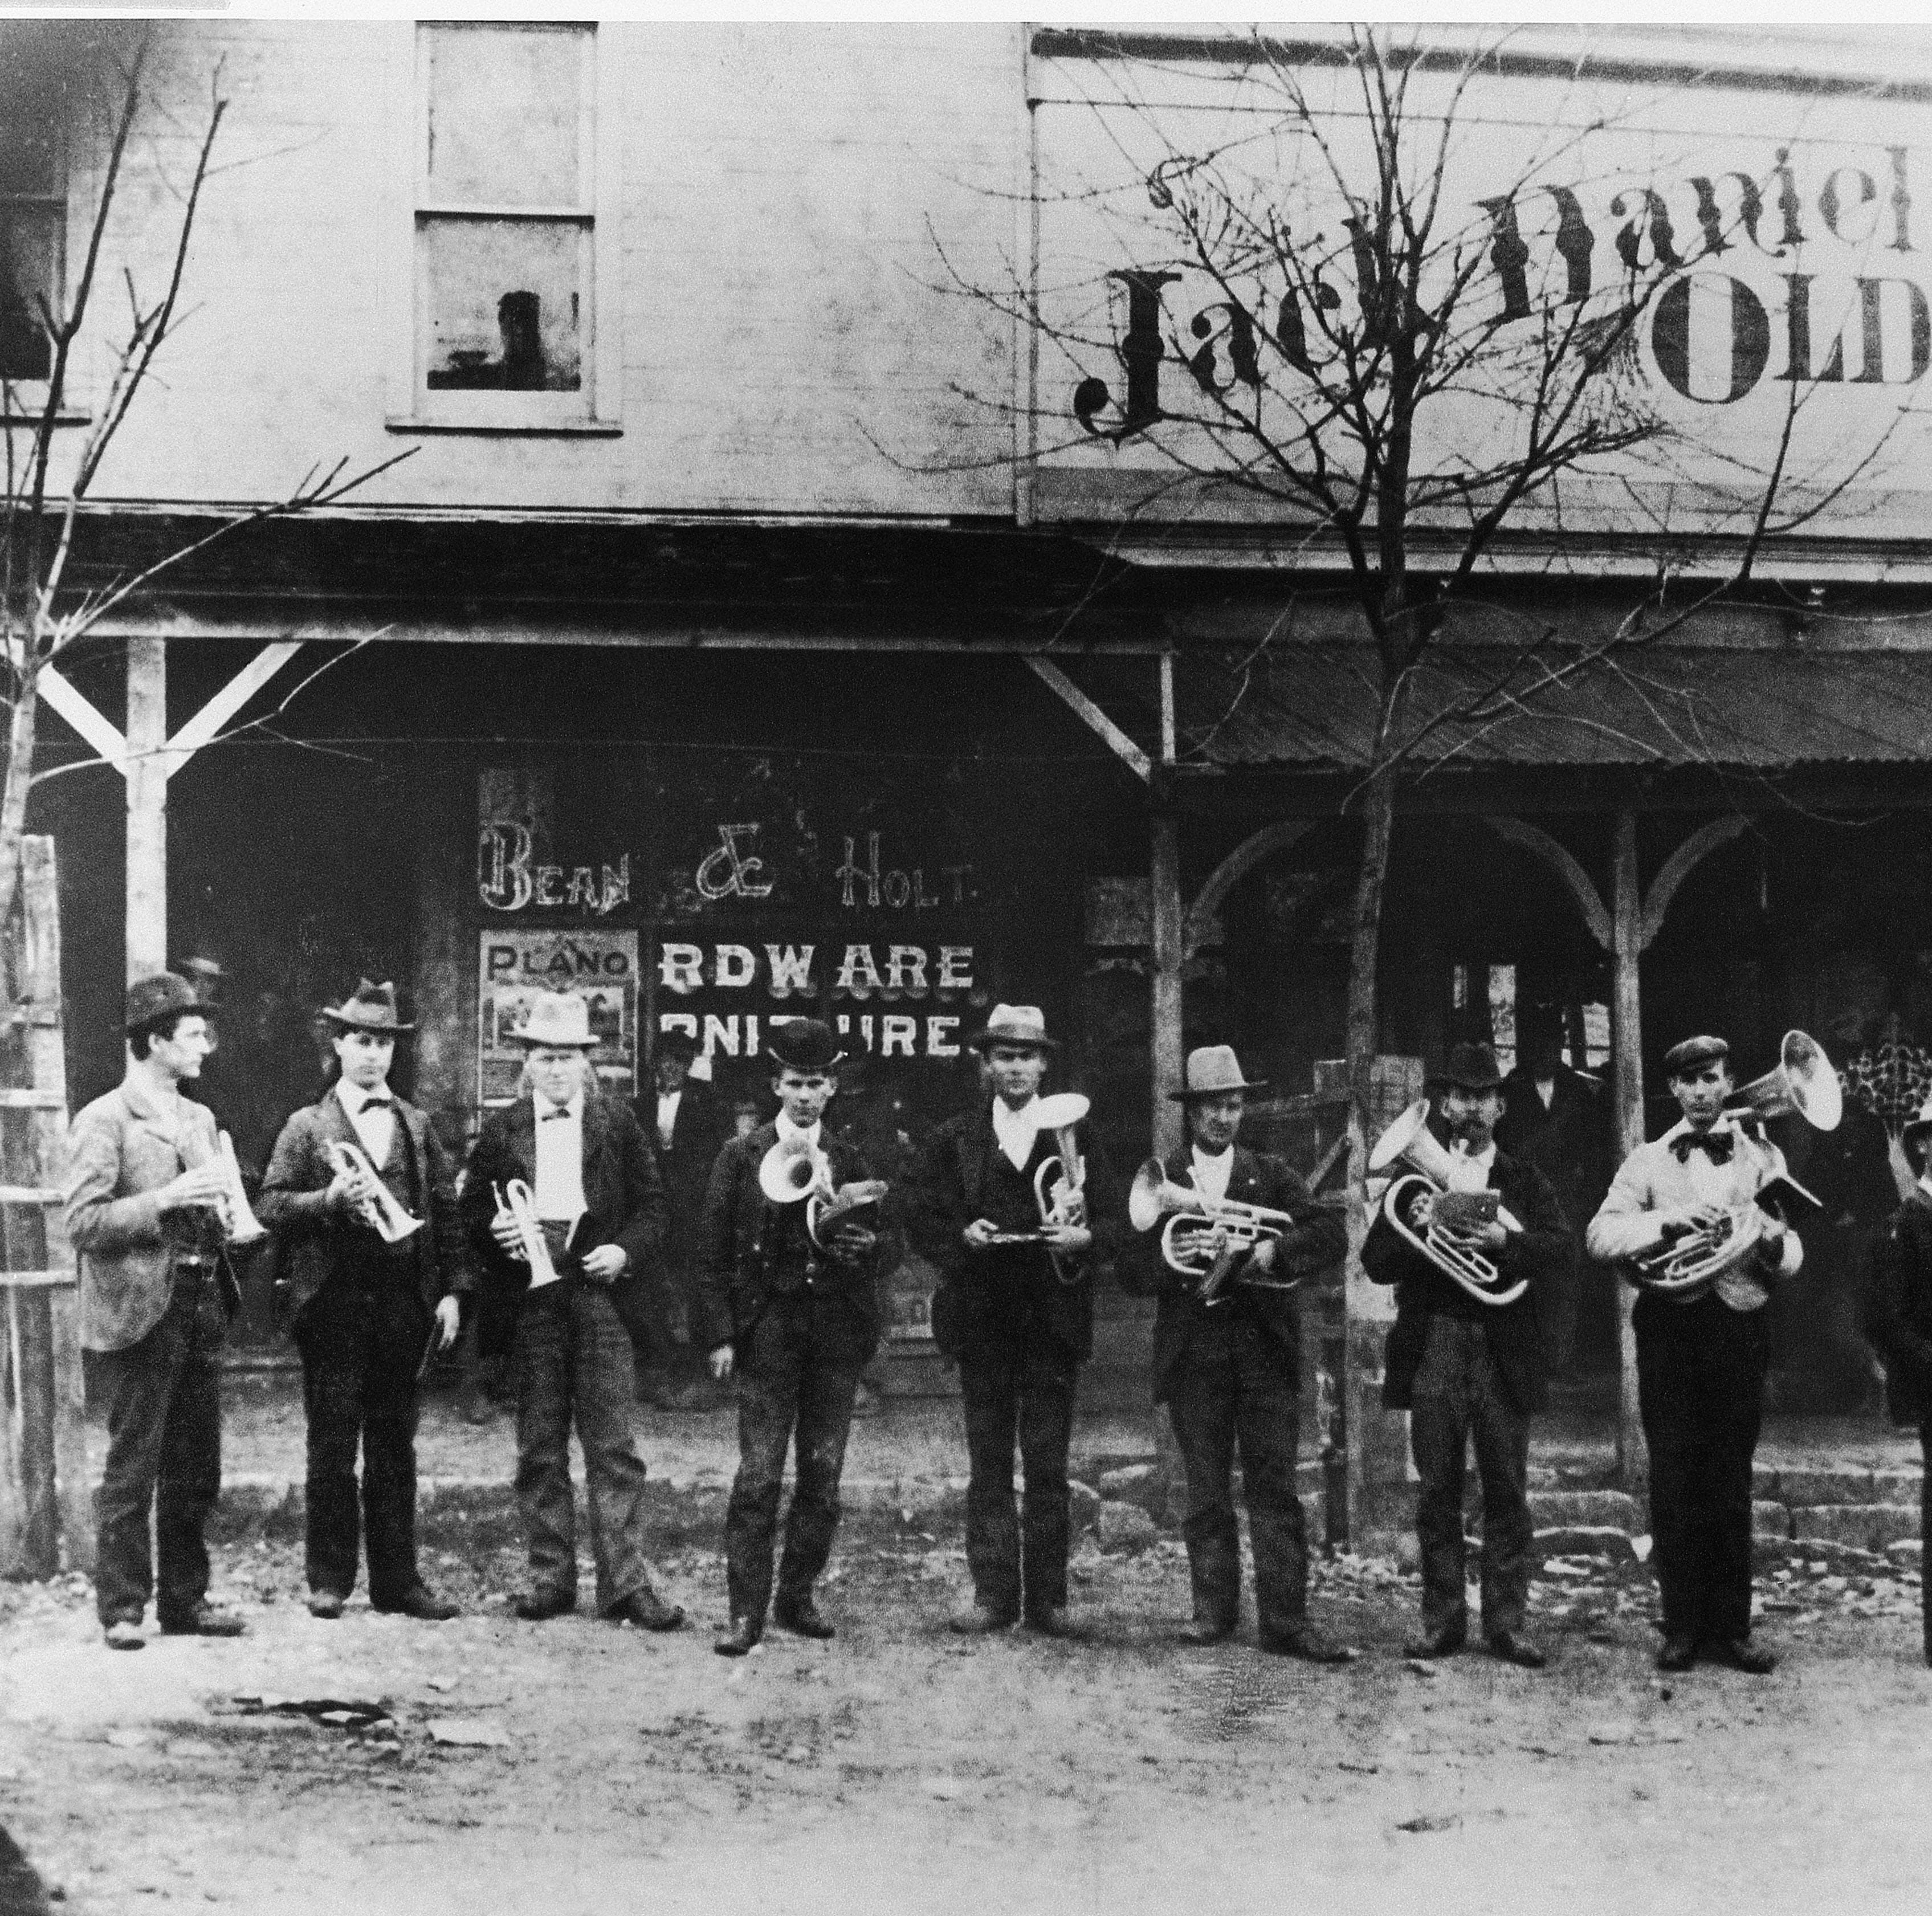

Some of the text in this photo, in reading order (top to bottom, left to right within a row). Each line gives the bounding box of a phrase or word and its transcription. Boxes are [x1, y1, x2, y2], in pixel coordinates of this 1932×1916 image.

[1650, 271, 1931, 403] OLD
[696, 822, 774, 900] &
[487, 944, 629, 981] PLANO
